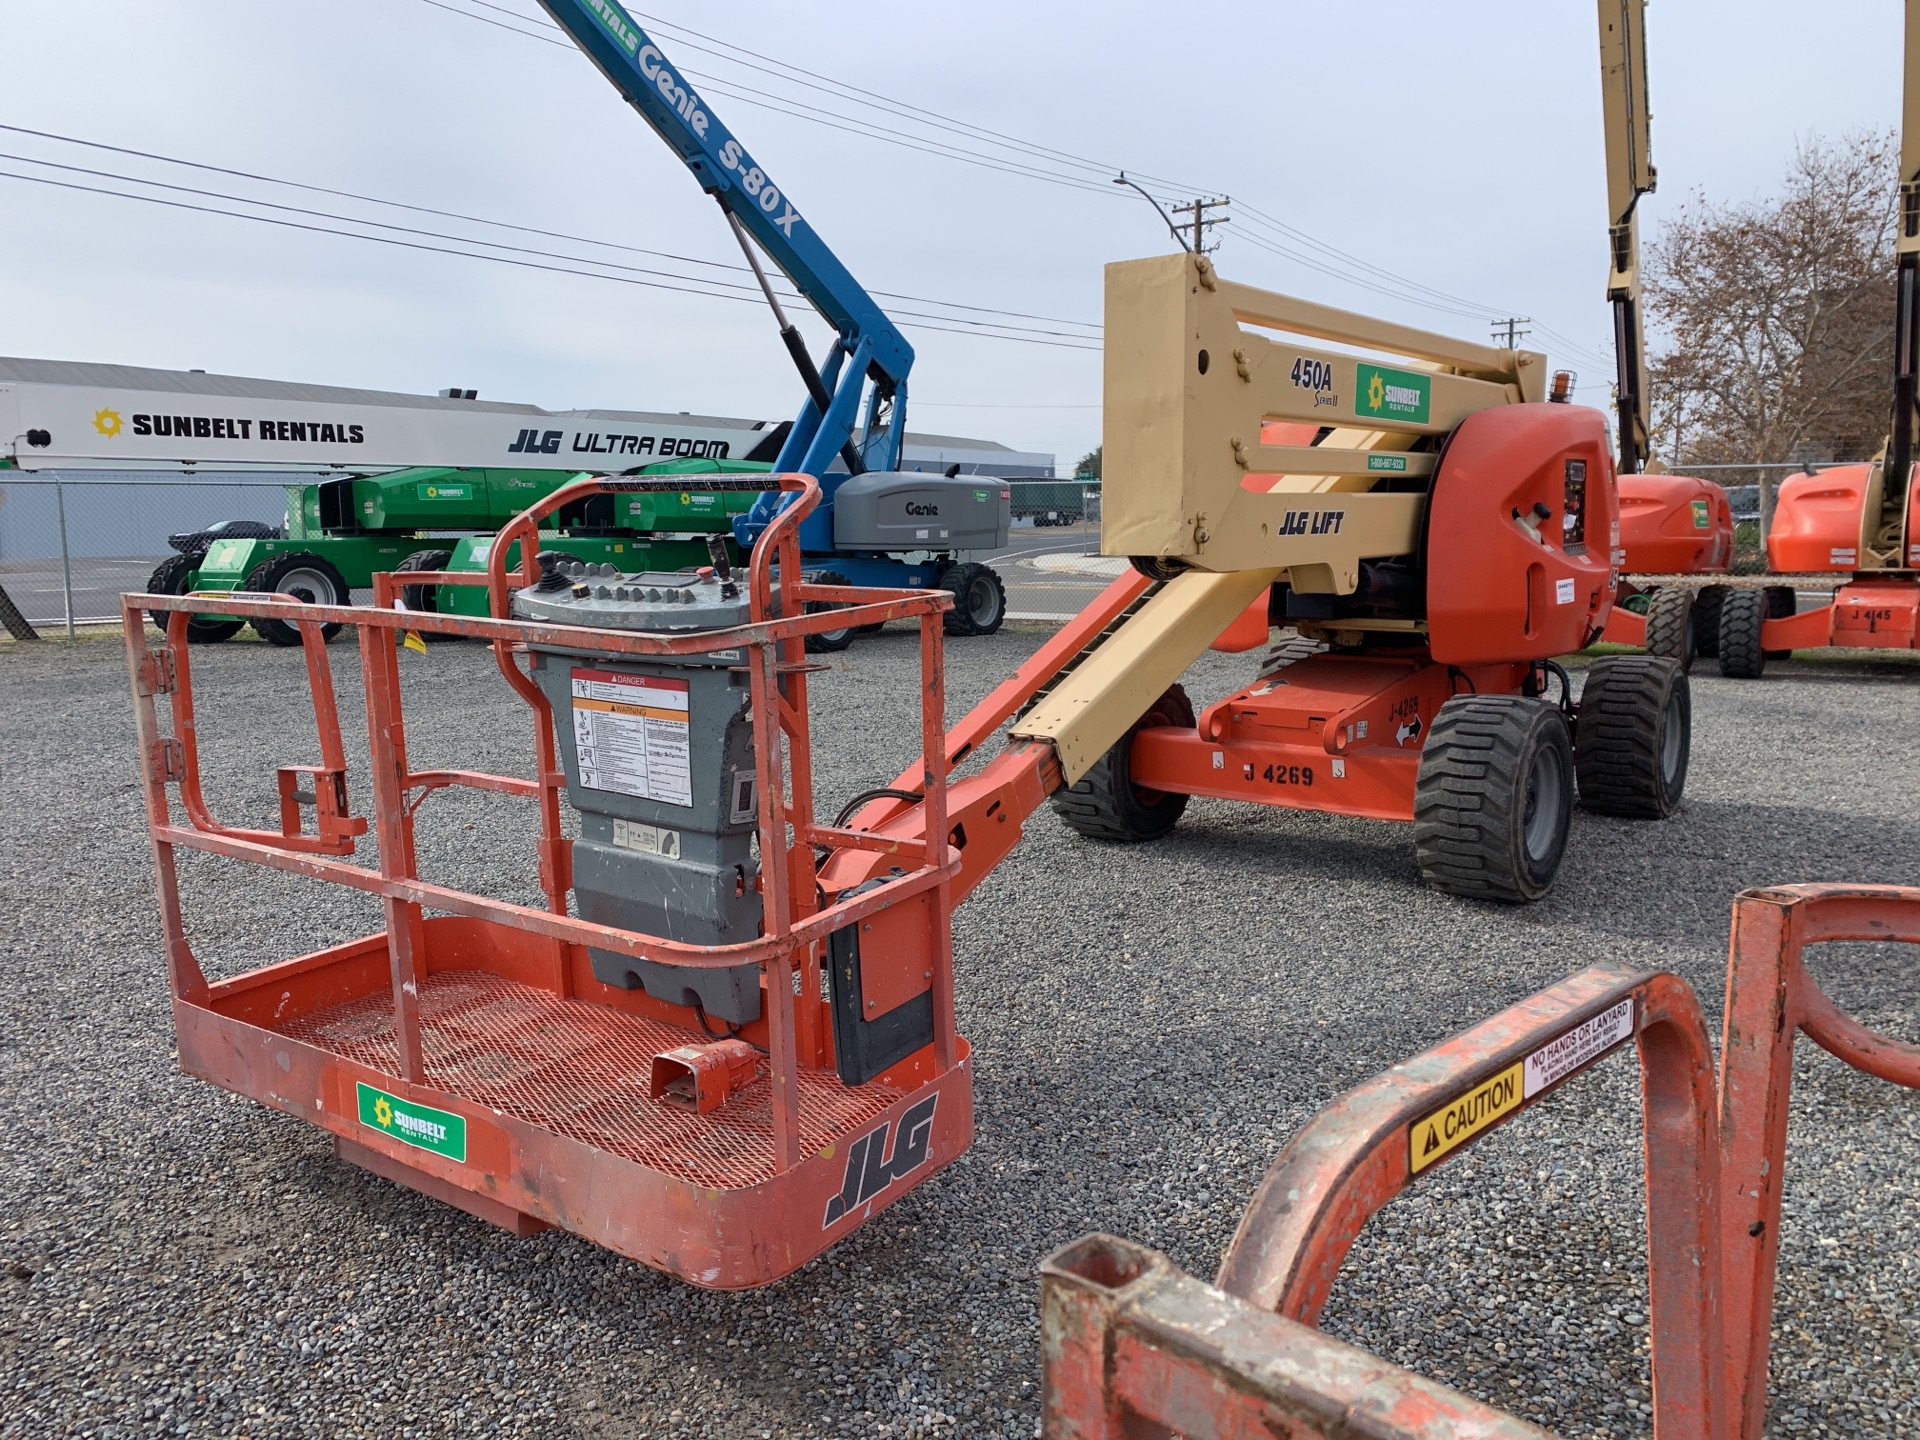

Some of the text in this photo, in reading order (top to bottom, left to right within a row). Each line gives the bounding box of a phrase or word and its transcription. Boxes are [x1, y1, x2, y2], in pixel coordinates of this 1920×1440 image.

[588, 0, 638, 51] NTALS
[638, 45, 709, 139] Genie
[1290, 357, 1333, 392] 450A
[1385, 384, 1421, 407] SUNBELT
[1389, 402, 1415, 413] RENTALS
[132, 413, 365, 444] SUNBELT RENTALS
[507, 429, 730, 459] JLG ULTRA BOOM
[905, 501, 939, 516] Genie
[1278, 511, 1345, 536] JLG LIFT
[617, 675, 646, 686] DANGER
[615, 704, 647, 716] WARNING
[1389, 695, 1419, 723] J-4269
[1244, 763, 1314, 787] J 4269
[1532, 1050, 1546, 1070] NO
[1547, 1031, 1577, 1060] HANDS
[1578, 1024, 1591, 1041] OR
[1592, 1002, 1628, 1033] LANYARD
[1541, 1053, 1564, 1075] PLACING
[1564, 1045, 1578, 1062] HAND
[1579, 1038, 1592, 1052] HERE
[1603, 1020, 1621, 1038] RESULT
[1576, 1043, 1602, 1065] MODERATE
[1444, 1073, 1515, 1141] CAUTION
[394, 1110, 447, 1140] SUNBELT
[400, 1127, 439, 1144] RENTALS
[822, 1090, 940, 1230] JLG
